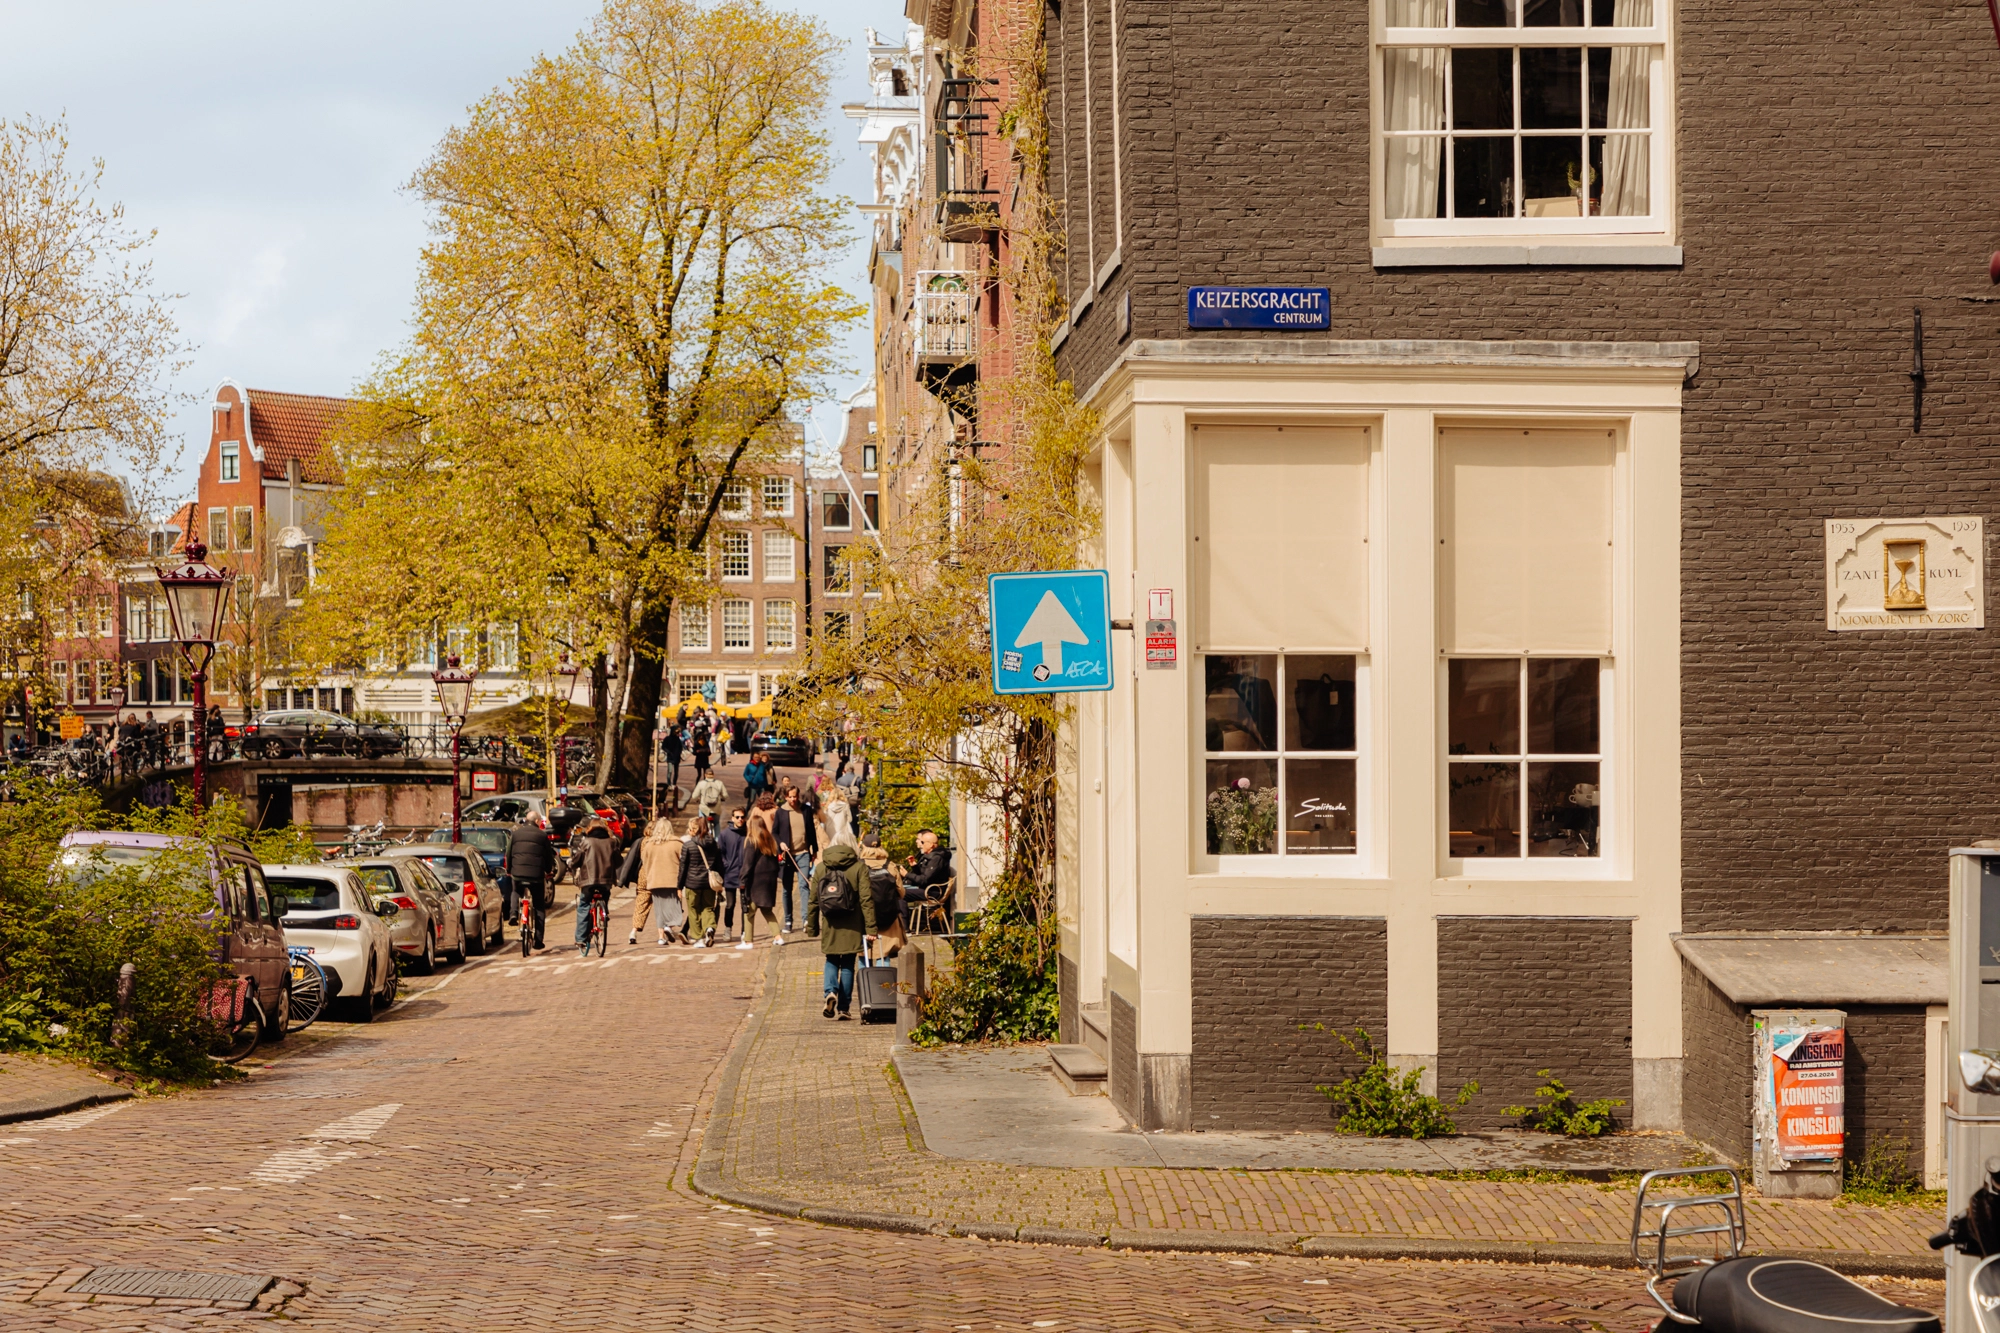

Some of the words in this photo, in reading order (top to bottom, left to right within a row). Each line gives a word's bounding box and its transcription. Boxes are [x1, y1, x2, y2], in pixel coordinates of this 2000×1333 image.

[1196, 292, 1321, 308] KEIZERSGRACHT
[1273, 313, 1322, 323] CENTRUM
[1831, 522, 1855, 534] 1953
[1843, 570, 1879, 580] ZANT
[1929, 568, 1962, 578] KUYL
[1840, 615, 1914, 626] MONUMENT
[1919, 614, 1933, 624] EN
[1937, 613, 1970, 623] ZORG
[1294, 797, 1347, 818] Solitude
[1791, 1043, 1843, 1061] KINGSLAND
